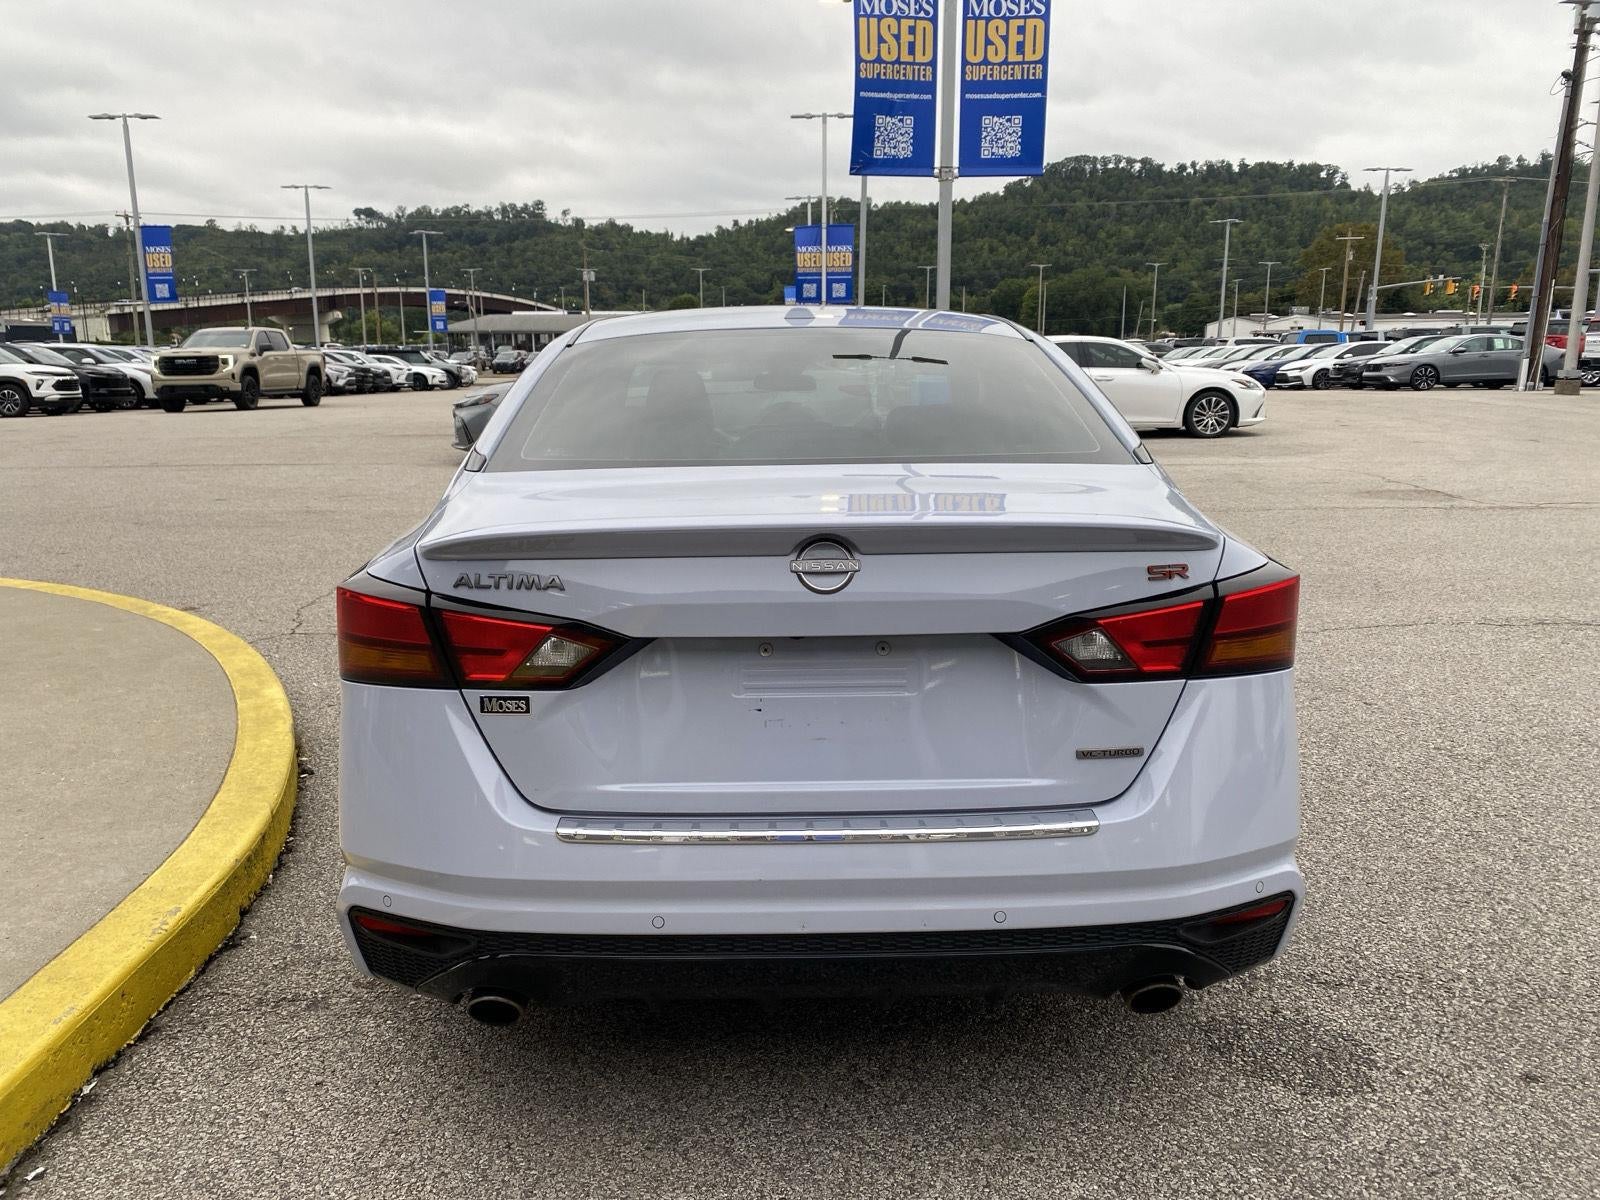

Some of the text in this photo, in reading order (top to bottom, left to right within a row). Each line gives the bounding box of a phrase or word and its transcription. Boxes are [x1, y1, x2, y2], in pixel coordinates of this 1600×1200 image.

[859, 0, 934, 17] MOSES
[967, 0, 1046, 17] MOSES
[858, 17, 934, 63] USED
[965, 18, 1046, 63] USED
[860, 62, 932, 81] SUPERCENTER
[965, 64, 1043, 80] SUPERCENTER
[860, 90, 932, 100] mosesusedsupercenter.com
[965, 92, 1042, 100] mosesusedsupercenter.com
[146, 253, 172, 268] USED
[797, 252, 822, 268] USED
[827, 252, 852, 267] USED
[792, 562, 859, 570] NISSAN
[1147, 563, 1189, 581] SR
[453, 573, 565, 591] ALTIMA
[1081, 748, 1140, 758] VC-TURBO
